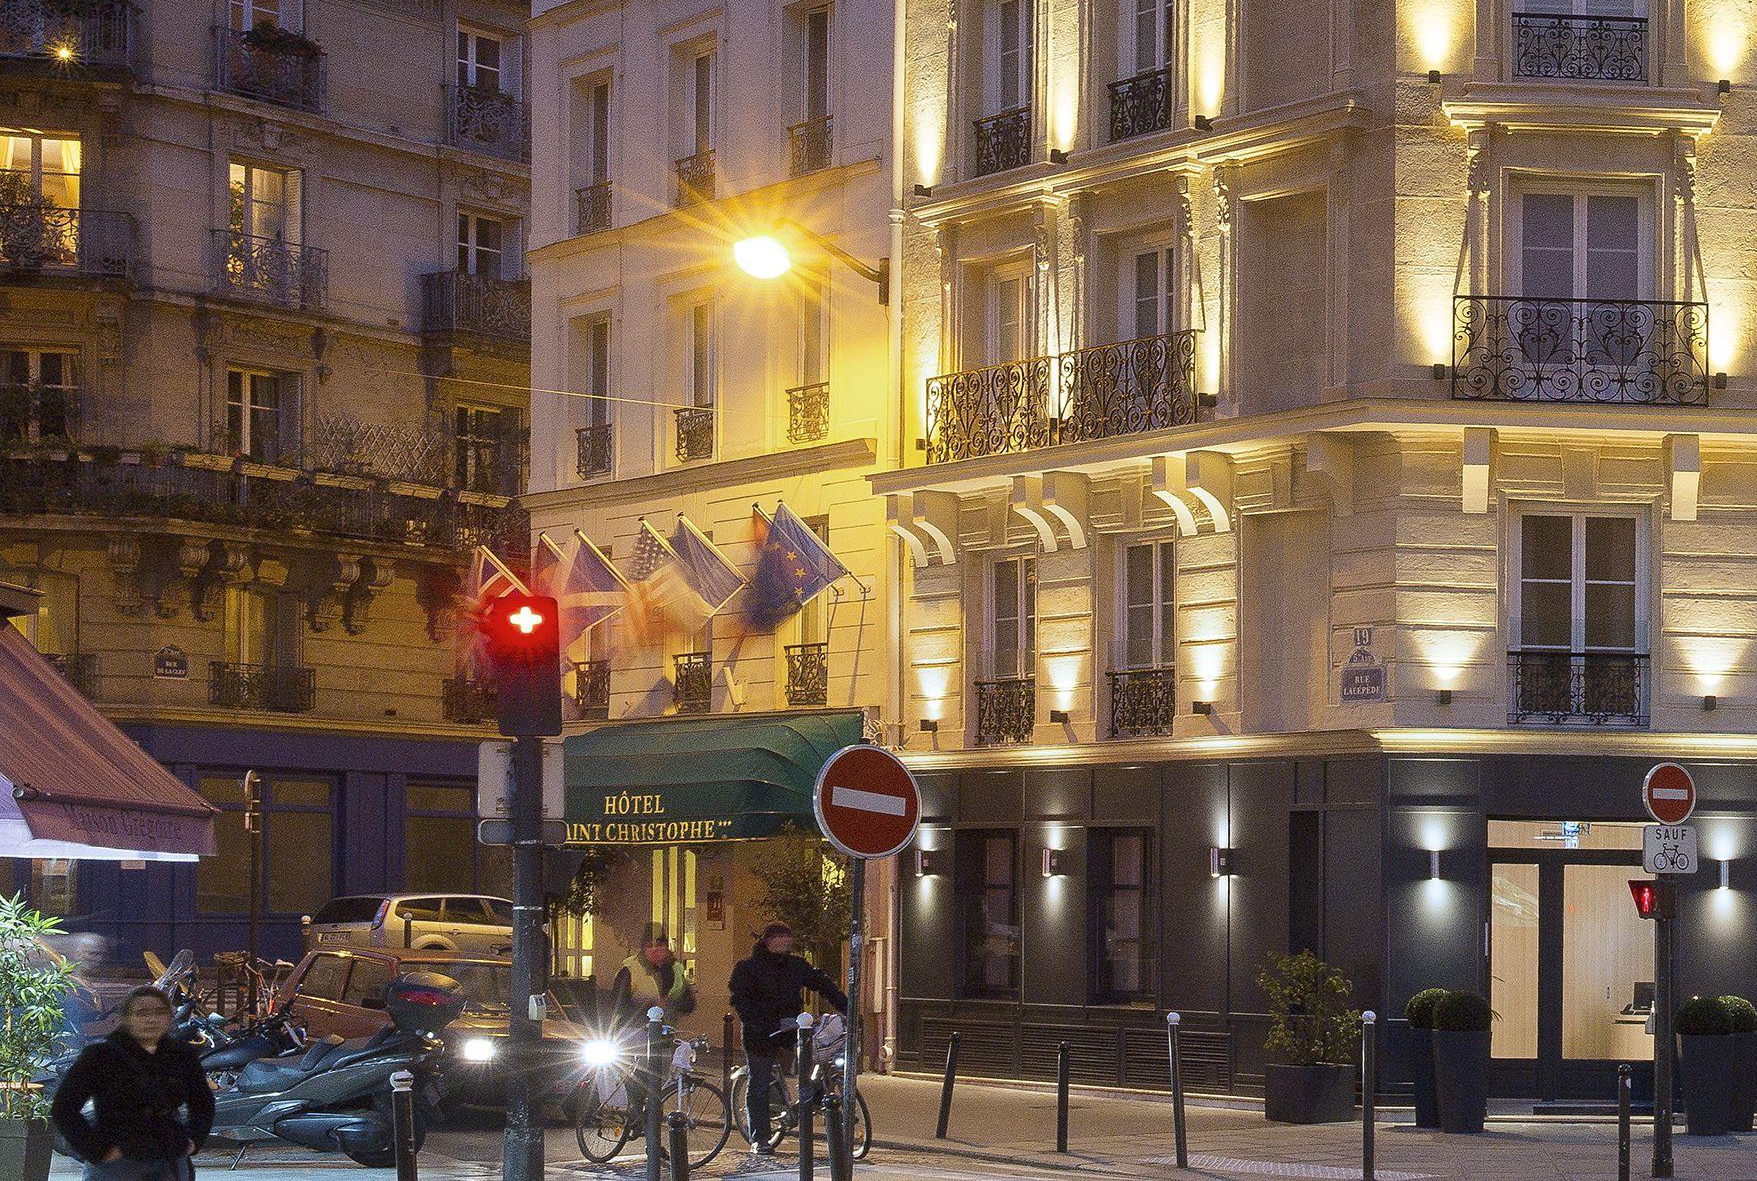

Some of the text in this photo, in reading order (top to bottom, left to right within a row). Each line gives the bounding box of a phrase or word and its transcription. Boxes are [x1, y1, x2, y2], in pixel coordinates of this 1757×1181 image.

[1356, 629, 1369, 645] 19
[1354, 675, 1371, 684] RUE
[604, 791, 665, 815] HÔTEL
[1655, 828, 1688, 840] SAUF
